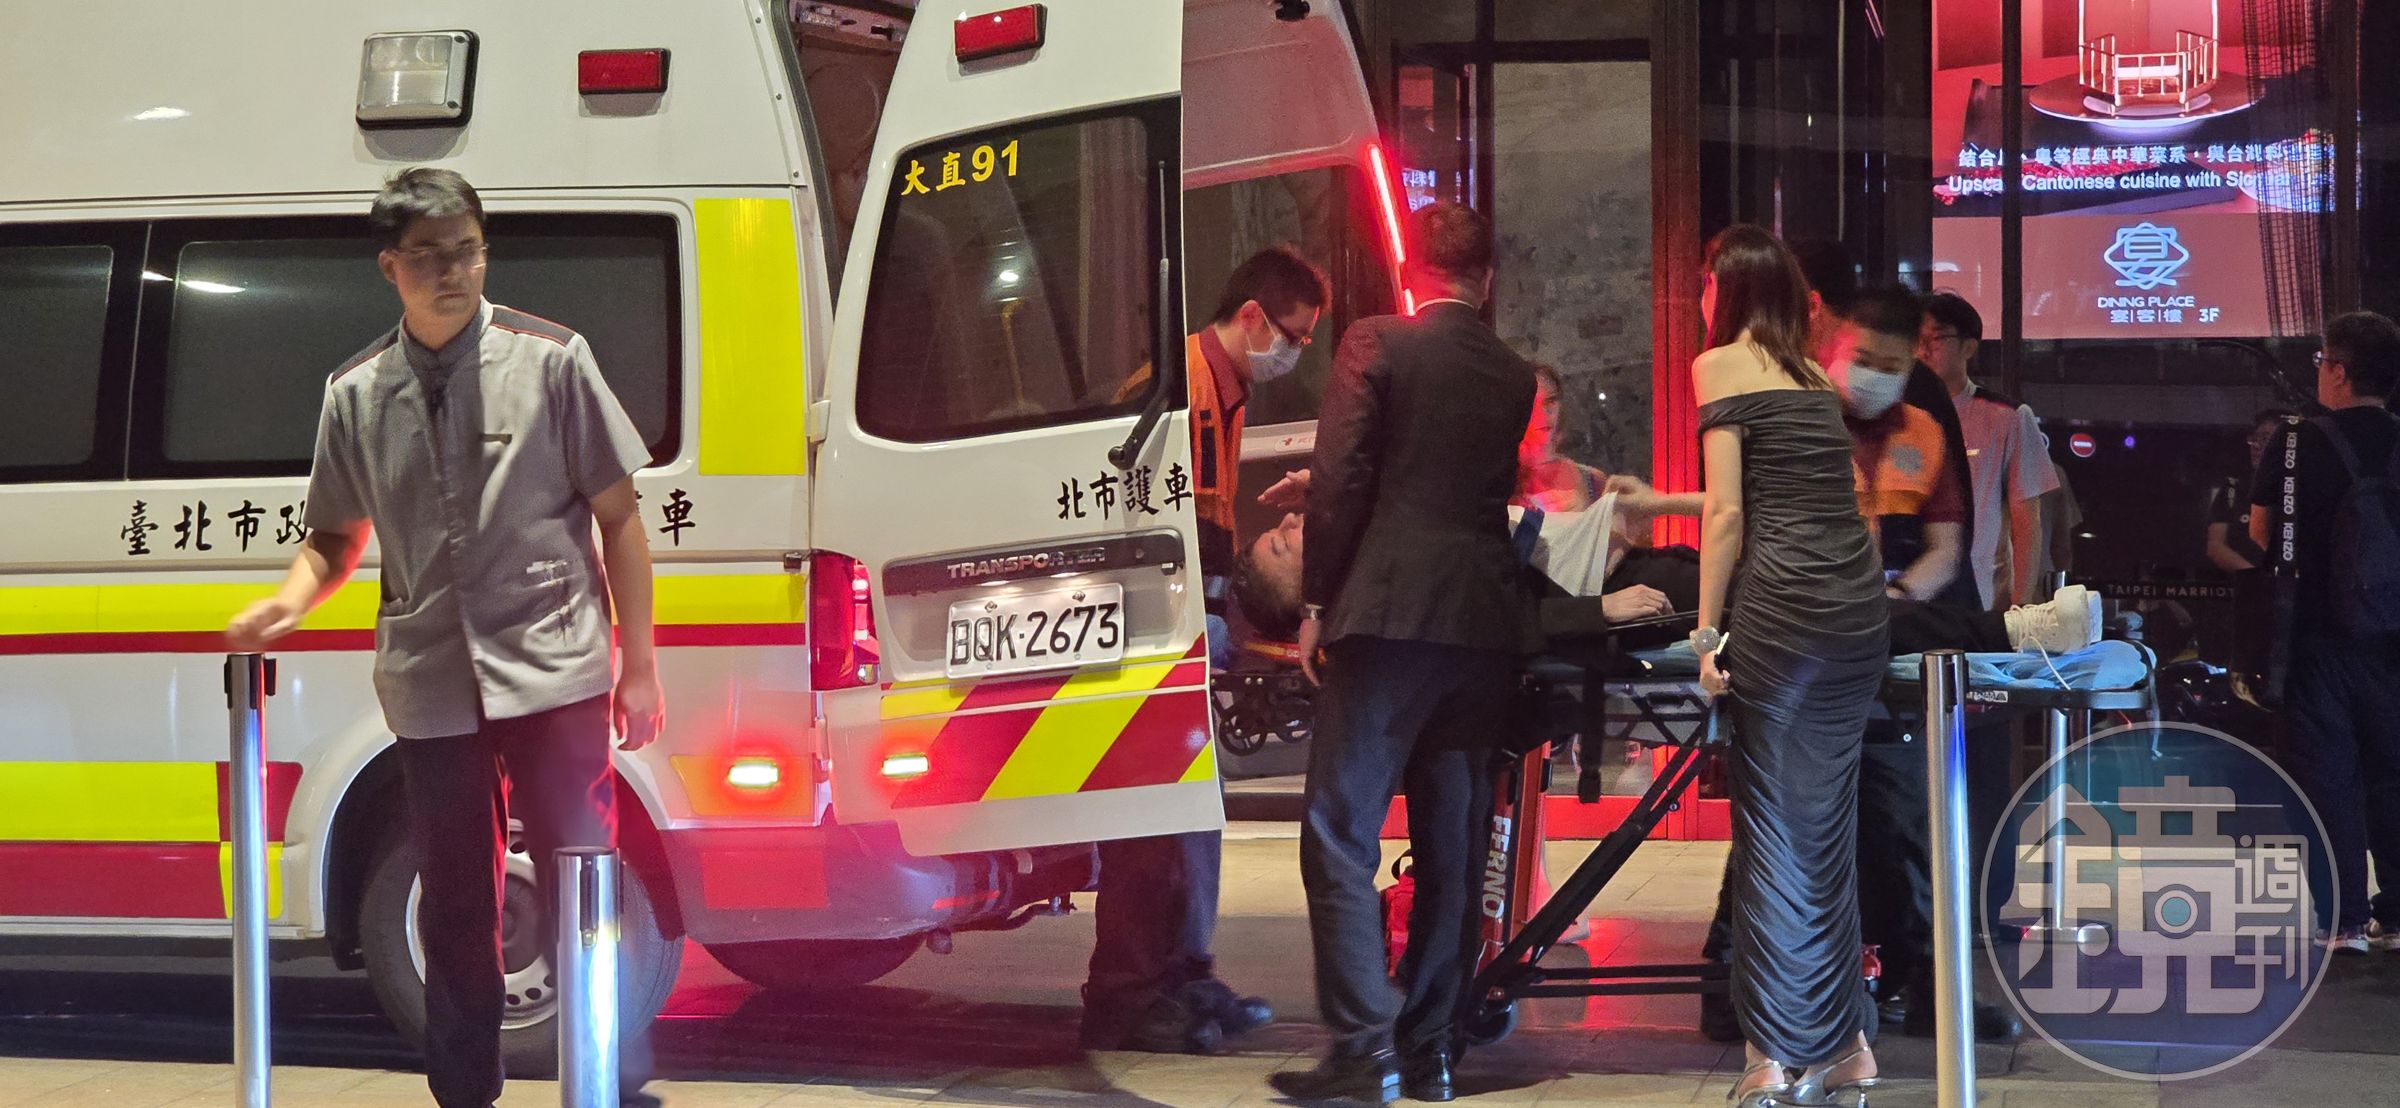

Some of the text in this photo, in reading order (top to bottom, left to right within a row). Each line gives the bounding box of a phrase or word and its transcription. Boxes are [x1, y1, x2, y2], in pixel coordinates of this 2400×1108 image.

[1949, 175, 2003, 196] Upsca
[2022, 174, 2116, 191] Cantonese
[2119, 172, 2181, 190] cuisine
[2186, 171, 2221, 188] with
[2097, 296, 2195, 308] DINING PLACE
[2199, 308, 2220, 322] 3F
[2285, 432, 2297, 469] KENZO
[1057, 463, 1193, 521] 北市護車
[2284, 477, 2295, 515] KENZO
[2283, 523, 2294, 561] KENZO
[947, 547, 1106, 579] TRANSPORTER
[2107, 584, 2157, 597] TAIPEI
[1481, 815, 1511, 920] FERNO
